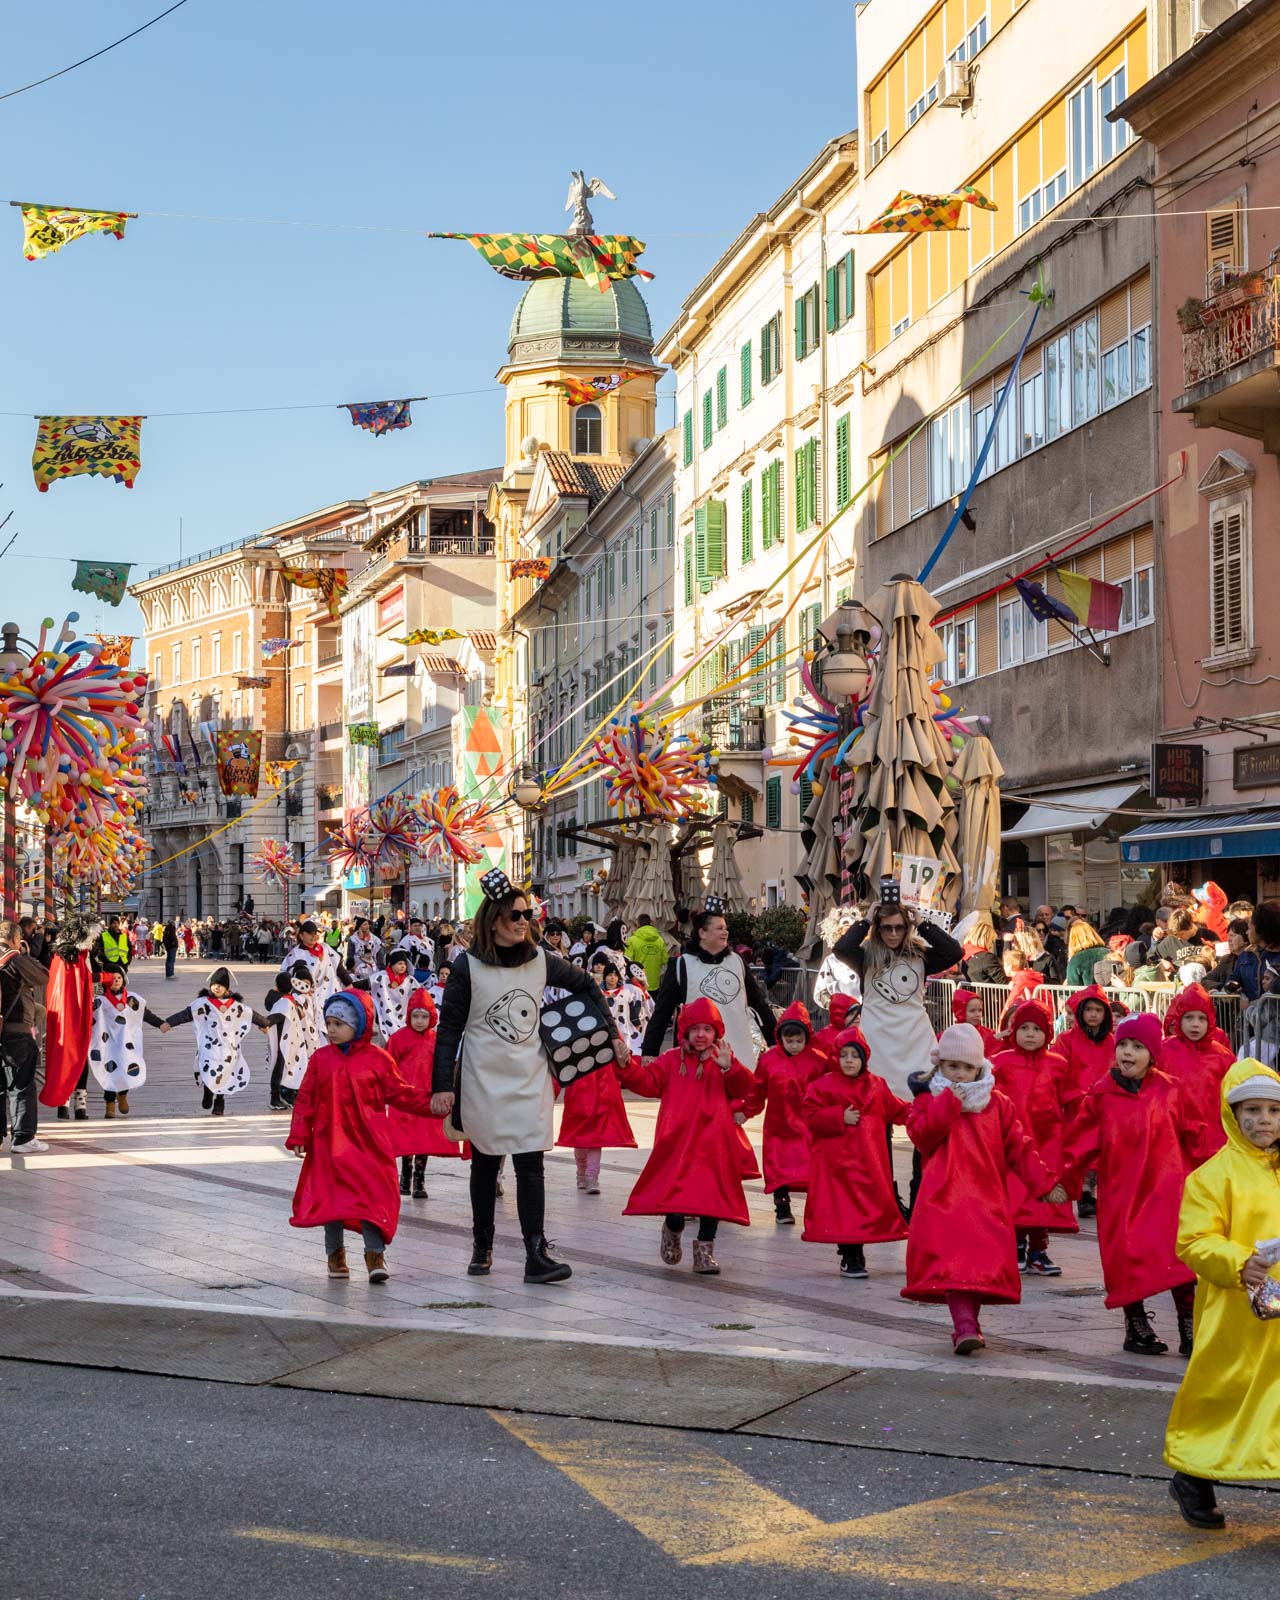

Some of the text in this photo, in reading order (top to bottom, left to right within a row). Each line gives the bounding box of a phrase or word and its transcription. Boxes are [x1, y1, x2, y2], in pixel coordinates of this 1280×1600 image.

[1168, 747, 1191, 765] HUG
[1159, 767, 1198, 786] PUNCH
[909, 863, 934, 885] 19
